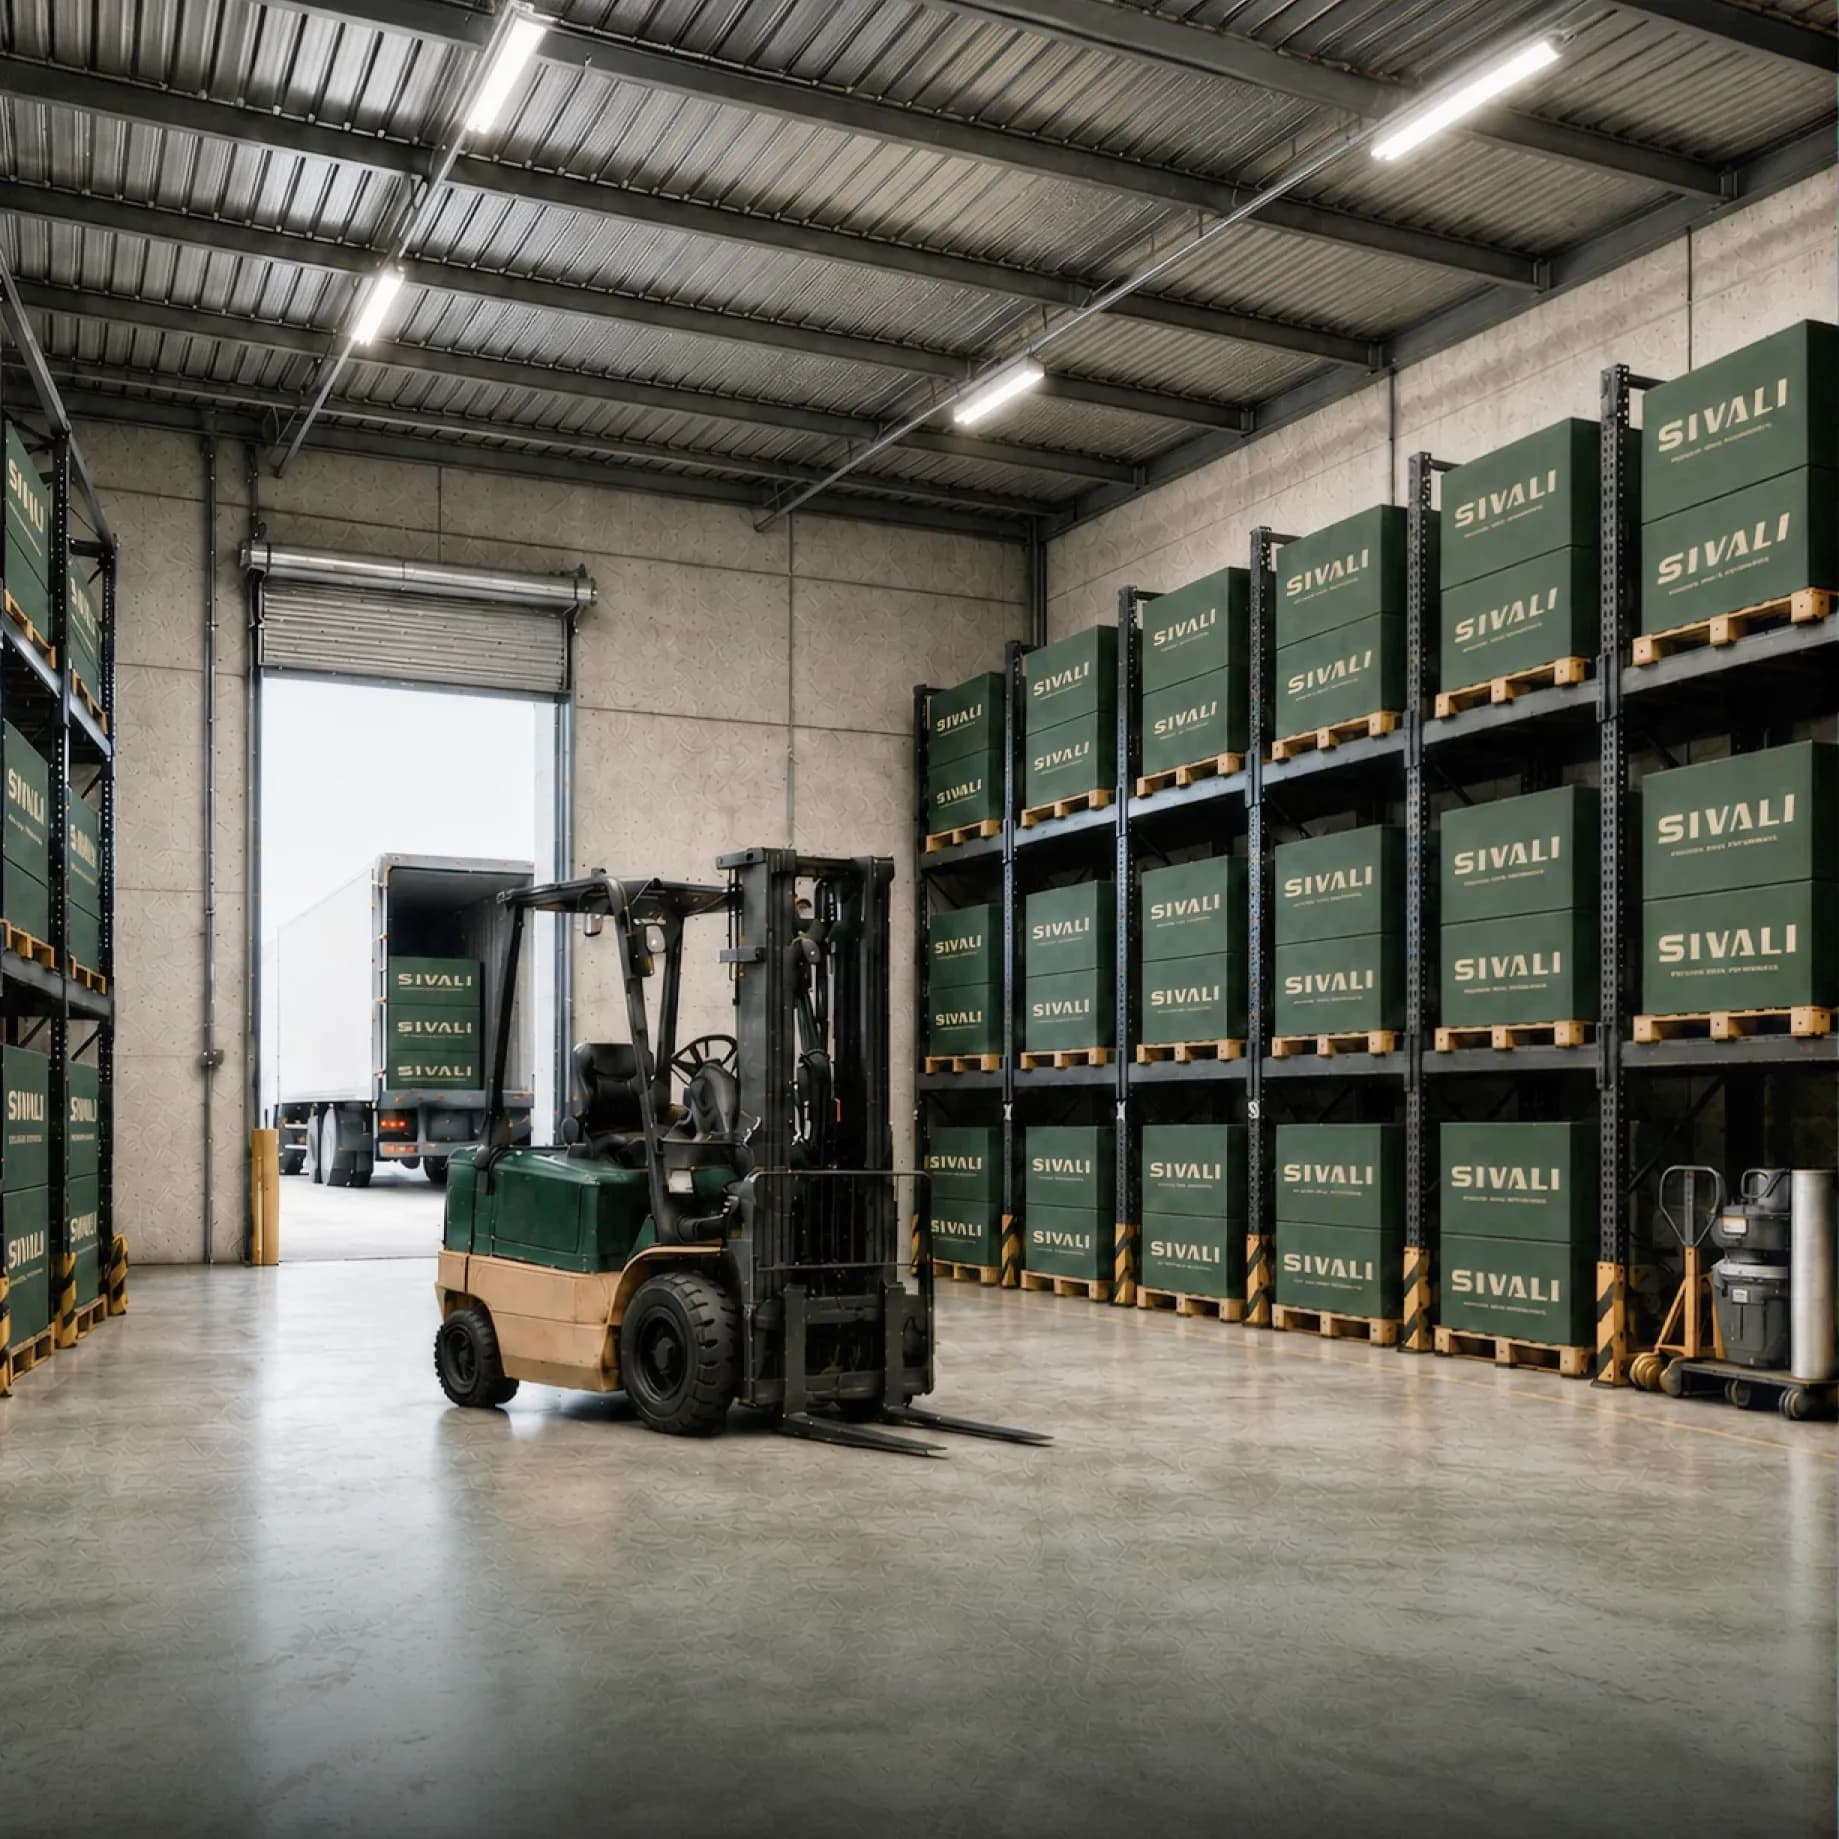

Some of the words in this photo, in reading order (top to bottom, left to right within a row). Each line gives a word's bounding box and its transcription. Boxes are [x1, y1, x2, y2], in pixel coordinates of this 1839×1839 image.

[1659, 379, 1786, 451] SIVALI
[1455, 470, 1555, 527] SIVALI
[1658, 513, 1789, 584] SIVALI
[1287, 549, 1368, 596] SIVALI
[1455, 588, 1557, 642] SIVALI
[1154, 609, 1215, 646] SIVALI
[1034, 662, 1088, 695] SIVALI
[1288, 651, 1371, 694] SIVALI
[938, 704, 981, 731] SIVALI
[1155, 702, 1216, 734] SIVALI
[1035, 742, 1089, 770] SIVALI
[938, 779, 981, 803] SIVALI
[1659, 794, 1794, 843] SIVALI
[1455, 837, 1559, 874] SIVALI
[1285, 866, 1371, 897] SIVALI
[1152, 895, 1219, 919] SIVALI
[1033, 918, 1089, 939] SIVALI
[936, 935, 981, 953] SIVALI
[1659, 925, 1796, 962] SIVALI
[1455, 952, 1560, 980] SIVALI
[397, 973, 472, 986] SIVALI
[1286, 971, 1372, 994] SIVALI
[1152, 986, 1218, 1005] SIVALI
[936, 1011, 981, 1025] SIVALI
[1033, 1000, 1089, 1016] SIVALI
[397, 1021, 472, 1034] SIVALI
[397, 1065, 472, 1077] SIVALI
[930, 1156, 981, 1169] SIVALI
[1033, 1159, 1090, 1173] SIVALI
[1151, 1163, 1220, 1179] SIVALI
[1284, 1164, 1372, 1184] SIVALI
[1452, 1166, 1559, 1190] SIVALI
[932, 1220, 981, 1236] SIVALI
[1034, 1231, 1089, 1248] SIVALI
[1152, 1241, 1219, 1262] SIVALI
[1284, 1254, 1372, 1280] SIVALI
[1452, 1270, 1558, 1301] SIVALI
